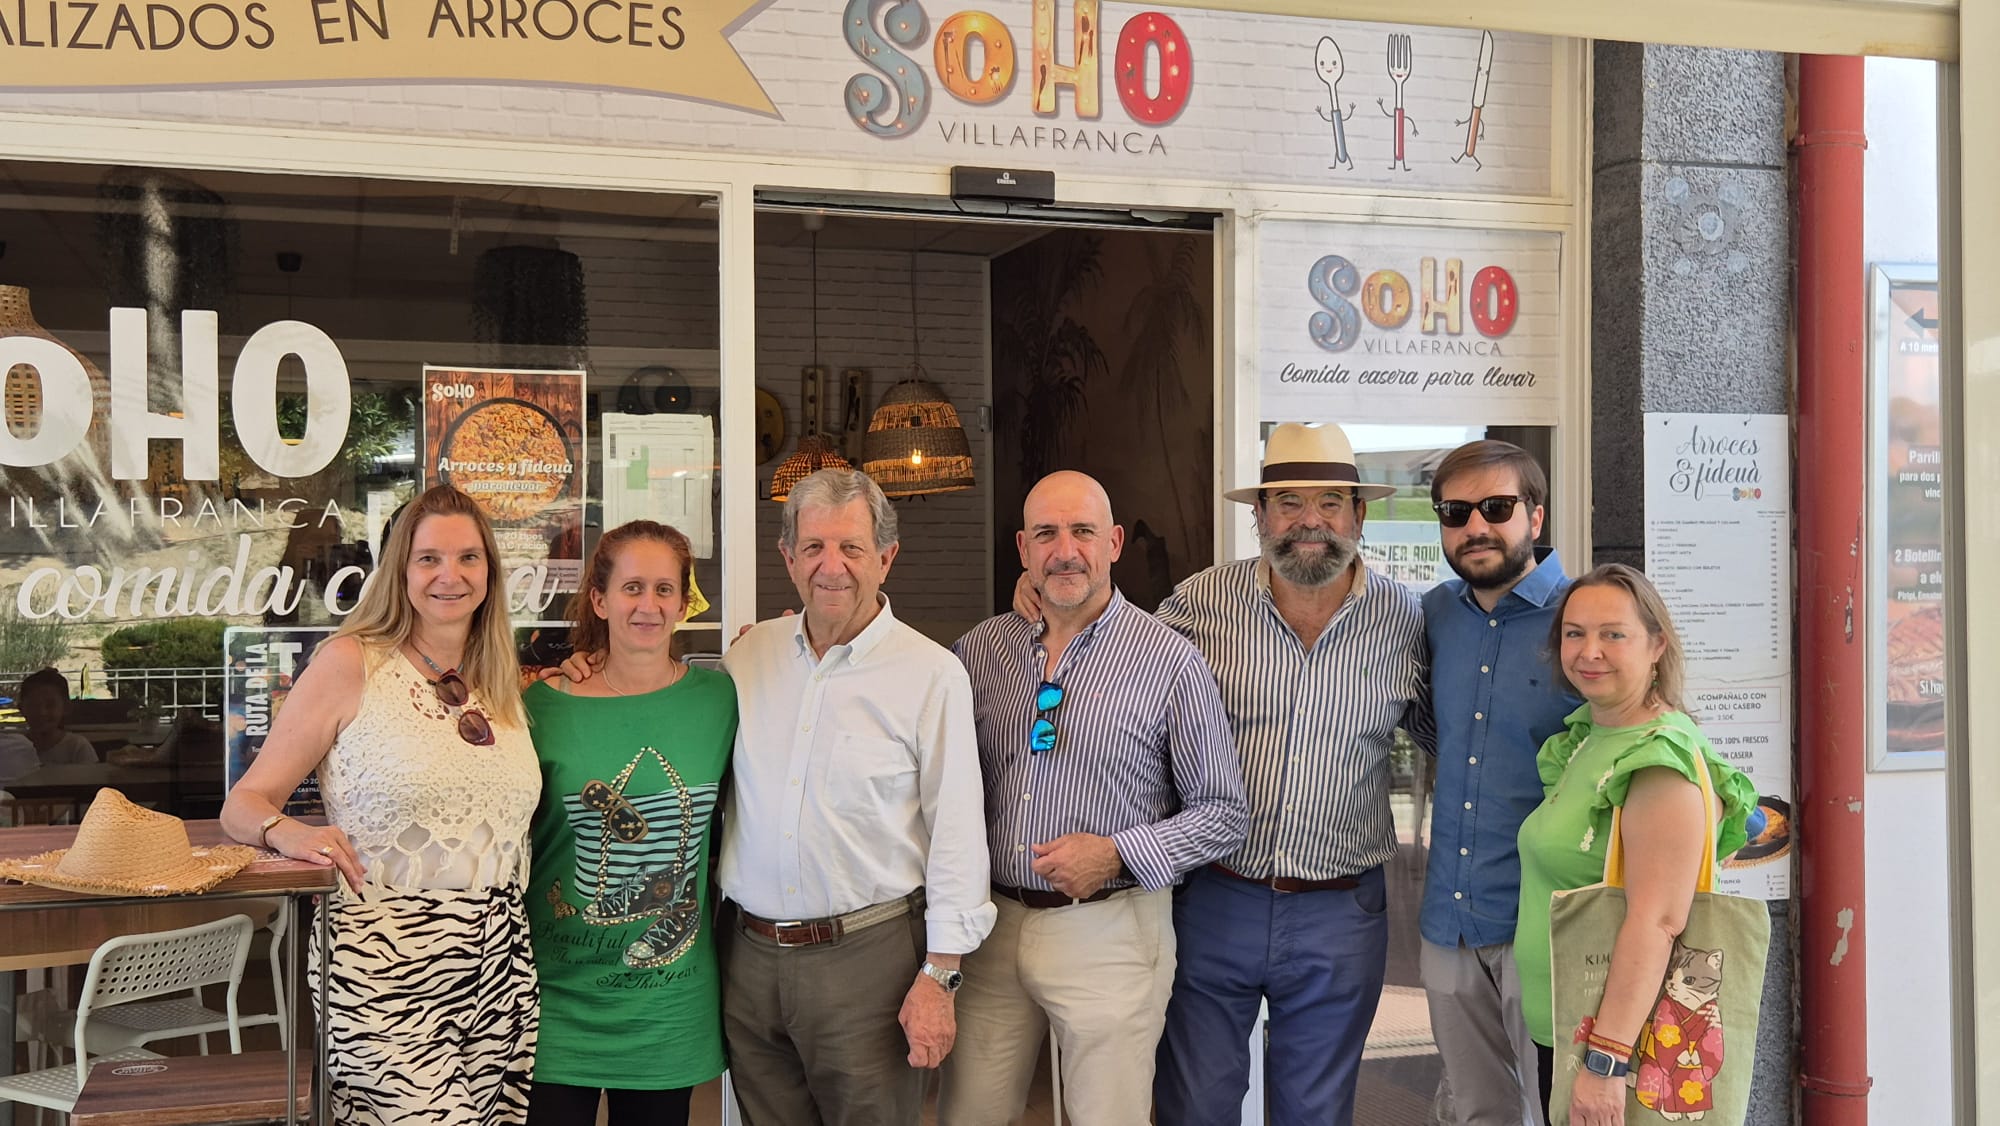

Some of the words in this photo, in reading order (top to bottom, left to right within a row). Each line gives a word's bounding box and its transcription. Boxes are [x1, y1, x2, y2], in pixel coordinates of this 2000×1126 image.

[311, 0, 389, 44] EN
[427, 0, 686, 50] ARROCES
[938, 120, 1168, 156] VILLAFRANCA
[1364, 338, 1503, 356] VILLAFRANCA
[1280, 362, 1350, 384] Comida
[1358, 369, 1419, 385] casera
[1421, 369, 1475, 392] para
[1482, 366, 1537, 388] llevar
[1676, 425, 1760, 455] Arroces
[438, 457, 504, 473] Arroces
[508, 462, 519, 475] y
[10, 496, 346, 529] ILLAFRANCA
[17, 533, 306, 619] comida
[246, 643, 268, 664] LA
[246, 666, 268, 689] DE
[1697, 692, 1749, 701] ACOMPAÑALO
[1733, 702, 1761, 710] CASERO
[246, 692, 268, 736] RUTA
[1743, 736, 1769, 744] FRESCOS
[1730, 751, 1753, 760] CASERA
